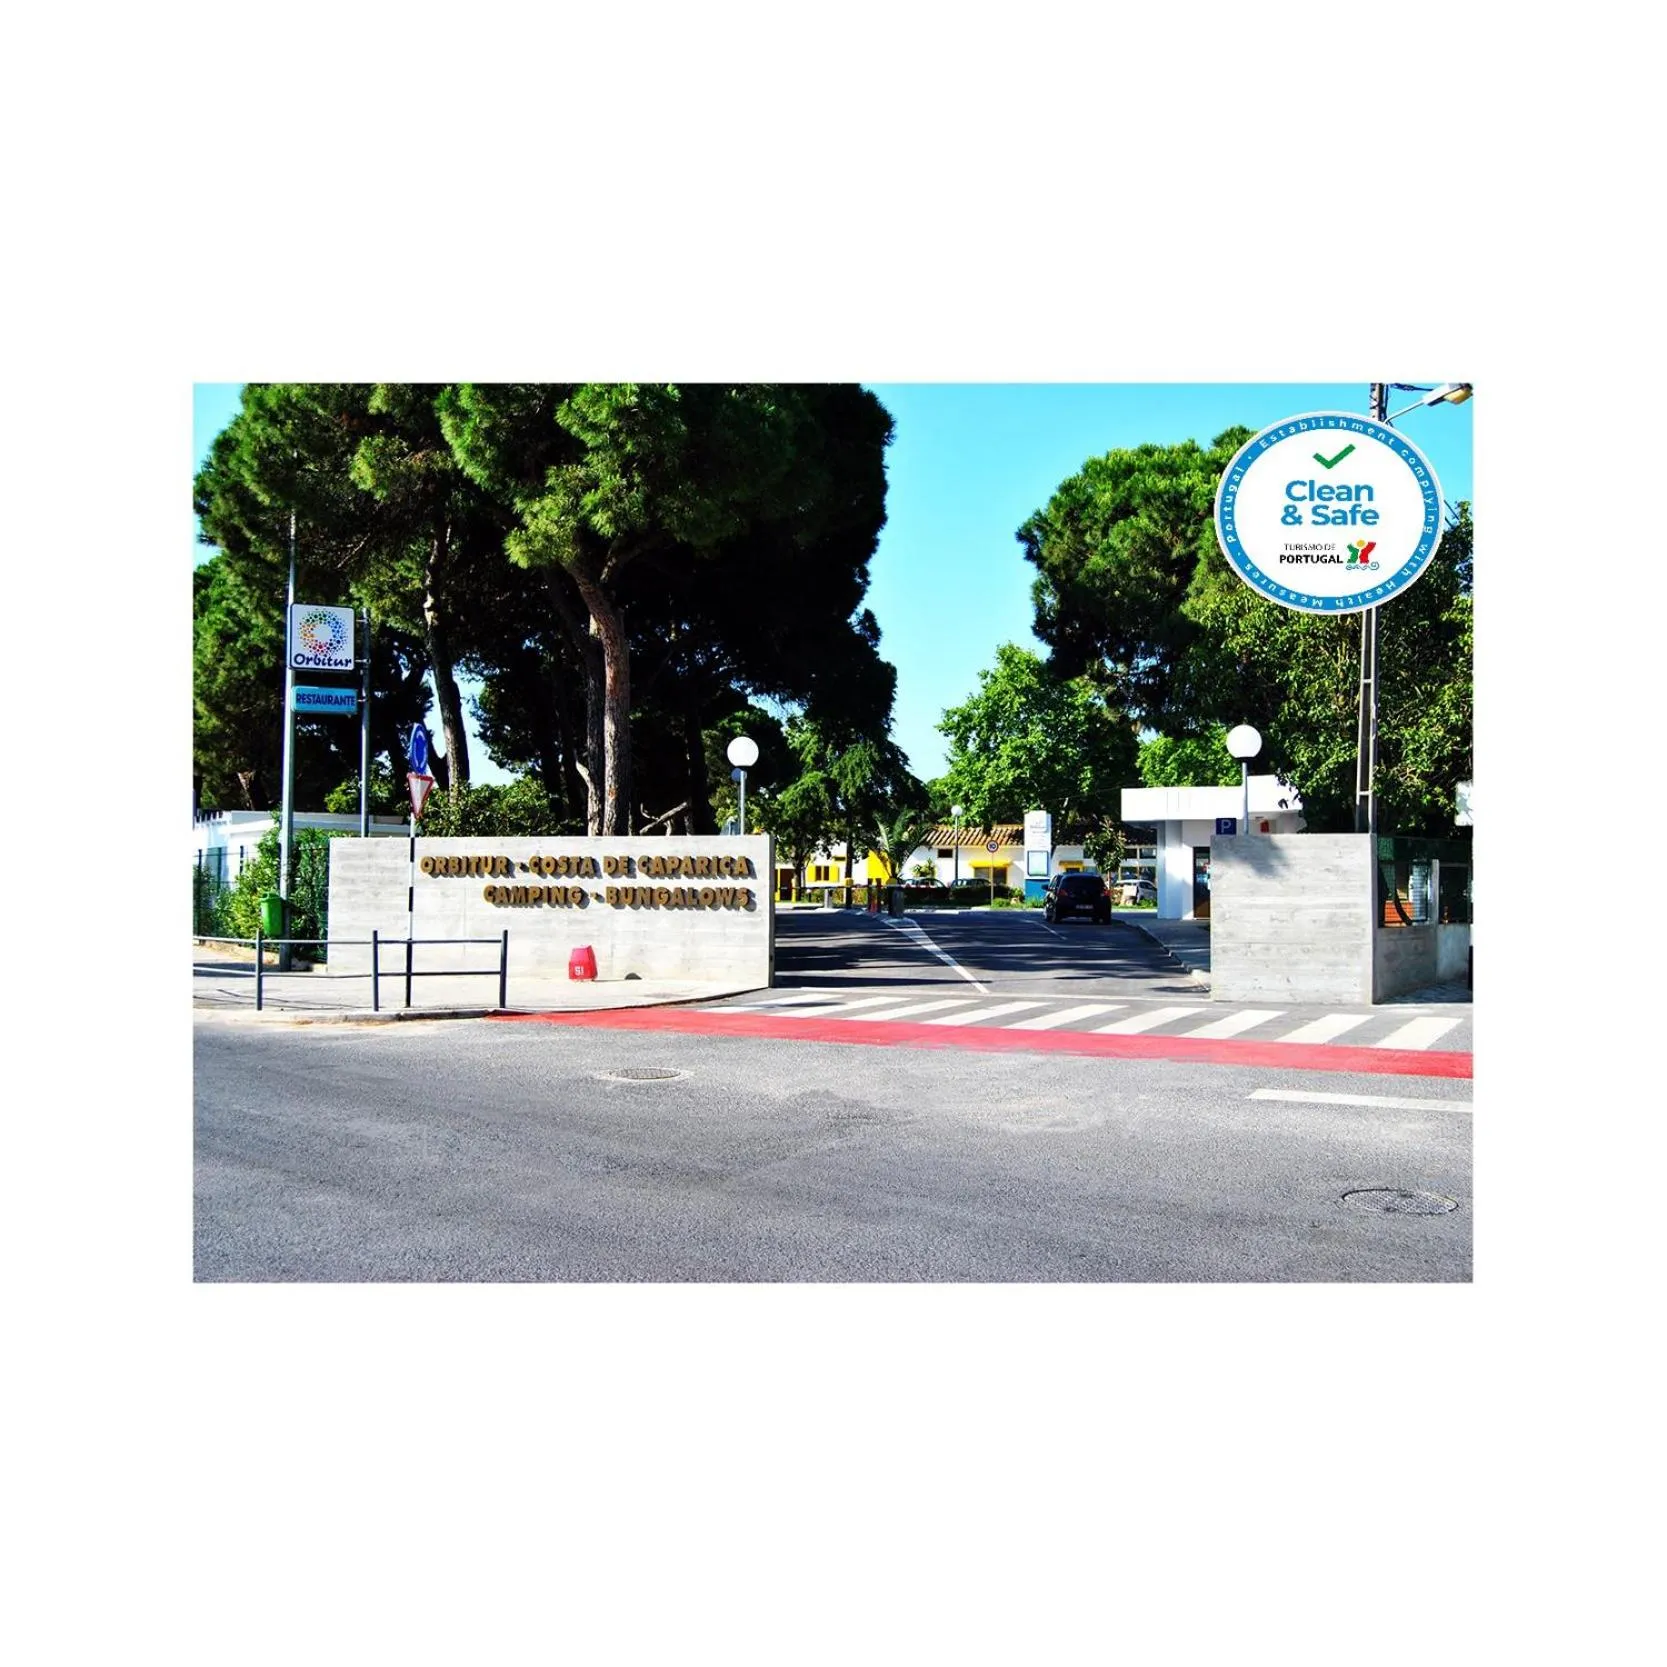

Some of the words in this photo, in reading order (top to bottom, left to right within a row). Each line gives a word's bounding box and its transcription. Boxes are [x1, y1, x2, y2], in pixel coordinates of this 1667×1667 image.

[294, 653, 352, 667] Orbitur
[295, 693, 356, 706] RESTAURANTE
[1220, 819, 1232, 834] P
[420, 855, 511, 875] ORBITUR
[528, 855, 597, 876] COSTA
[602, 855, 631, 876] DE
[637, 855, 752, 877] CAPARICA
[482, 884, 584, 905] CAMPING
[605, 886, 751, 908] BUNGALOWS
